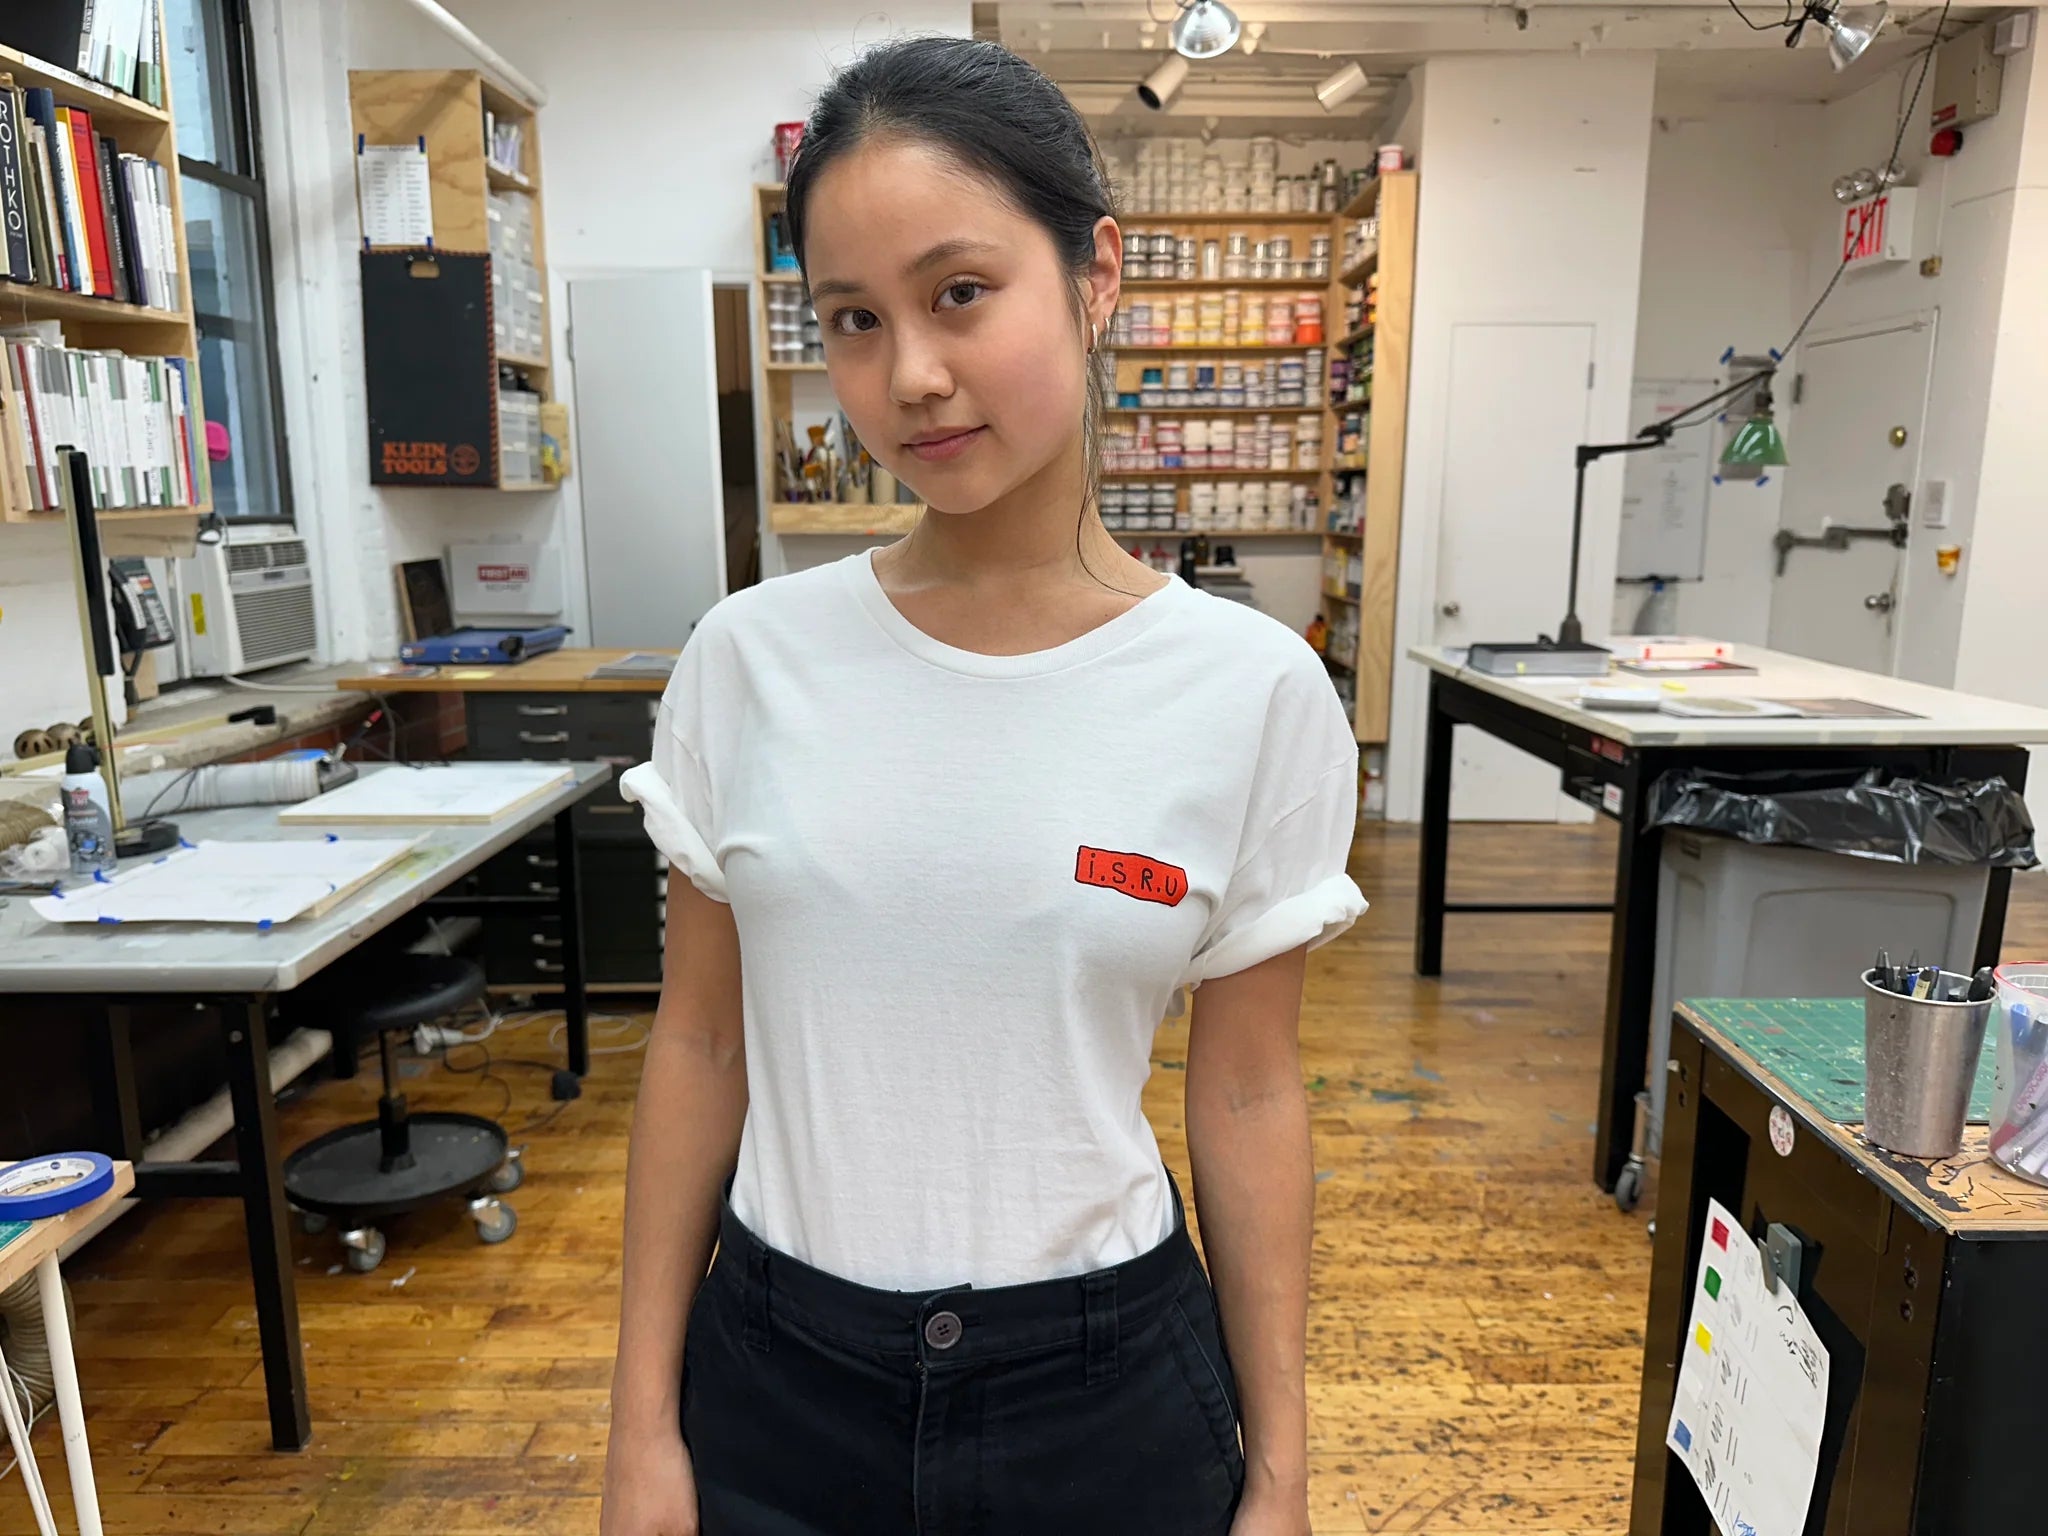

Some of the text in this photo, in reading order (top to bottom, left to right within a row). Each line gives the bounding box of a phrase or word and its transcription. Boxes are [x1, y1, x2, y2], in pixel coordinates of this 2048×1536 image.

[0, 101, 22, 231] ROTHKO
[1843, 198, 1887, 262] EXIT
[382, 459, 447, 475] TOOLS
[383, 442, 447, 458] KLEIN
[1088, 852, 1178, 897] i.S.R.U
